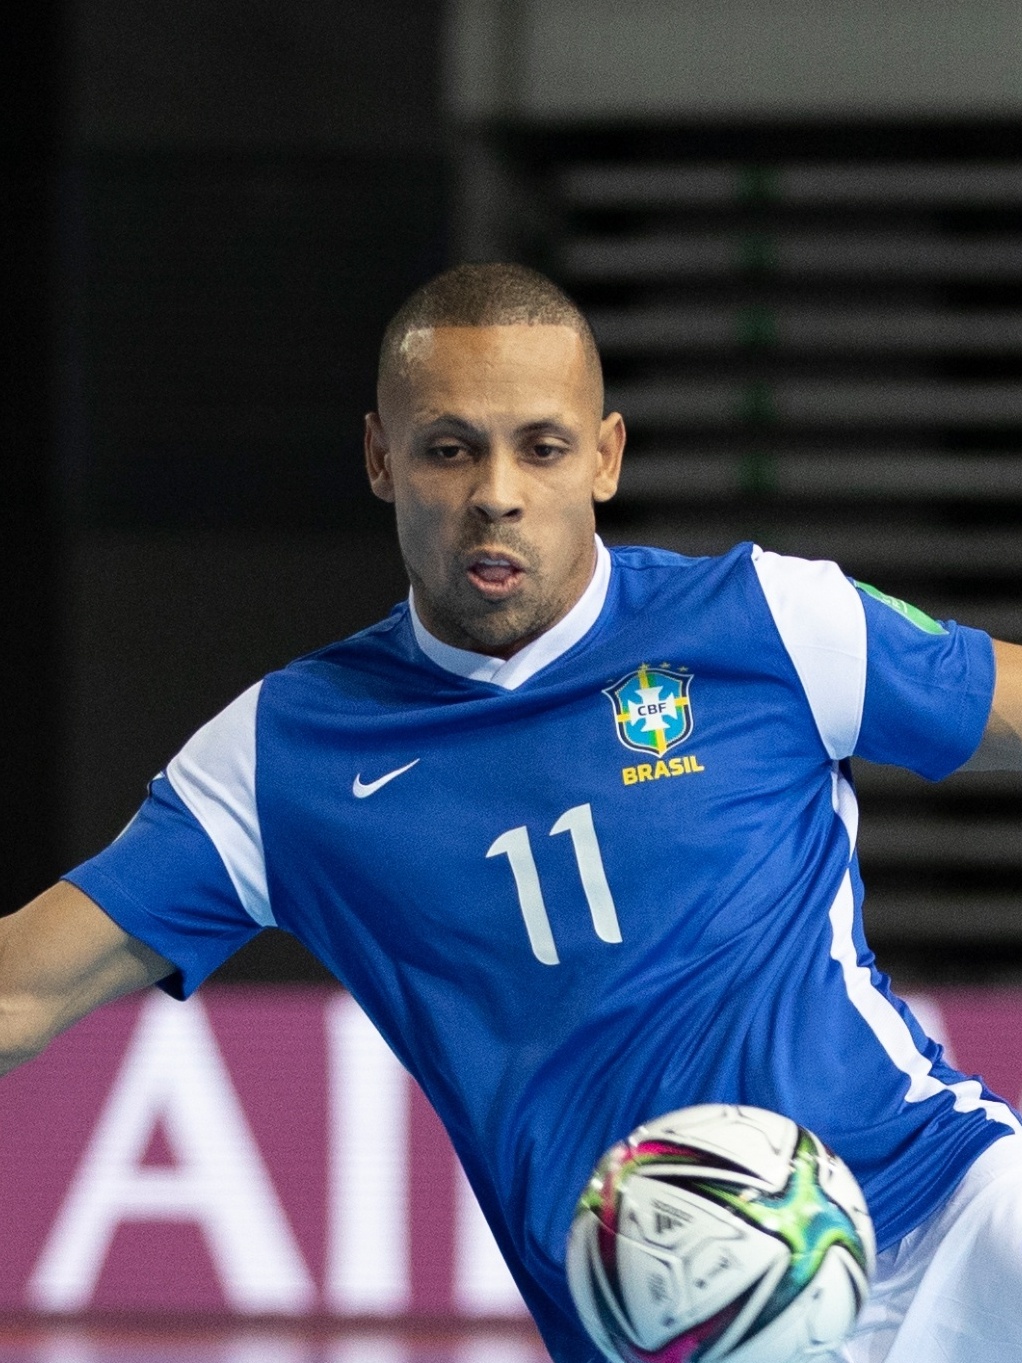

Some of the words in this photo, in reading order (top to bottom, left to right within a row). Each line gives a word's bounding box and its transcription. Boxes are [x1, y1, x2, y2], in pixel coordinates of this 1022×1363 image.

[637, 702, 667, 717] CBF
[622, 755, 705, 785] BRASIL
[485, 803, 623, 966] 11
